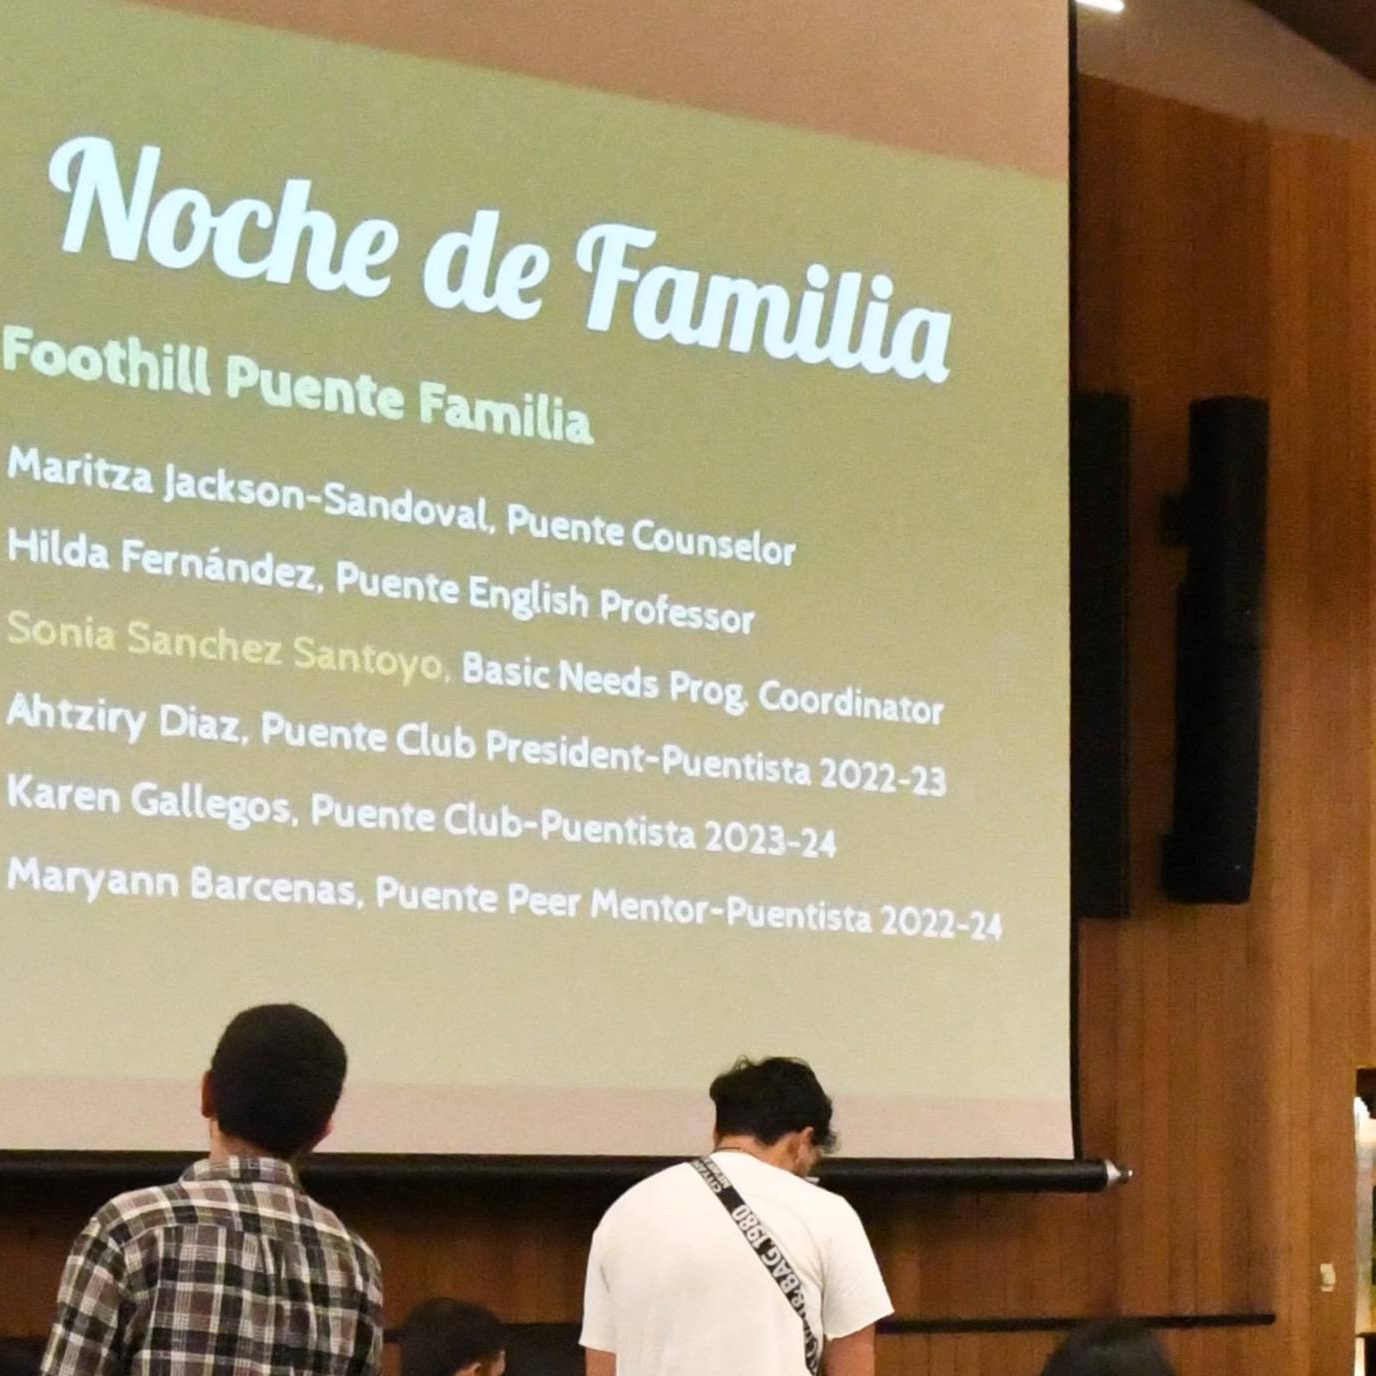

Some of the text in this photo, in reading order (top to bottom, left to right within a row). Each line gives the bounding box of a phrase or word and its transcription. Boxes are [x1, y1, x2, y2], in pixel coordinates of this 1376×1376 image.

[48, 134, 952, 384] Noche de Familia
[3, 324, 594, 445] Foothill Puente Familia
[7, 444, 796, 566] Maritza Jackson-Sandoval, Puente Counselor
[7, 527, 756, 635] Hilda Fernández, Puente English Professor
[7, 610, 944, 725] Sonia Sanchez Santoyo, Basic Needs Prog. Coordinator
[6, 691, 947, 797] Ahtziry Diaz, Puente Club President-Puentista 2022-23
[7, 773, 837, 858] Karen Gallegos, Puente Club-Puentista 2023-24
[7, 856, 1003, 941] Maryann Barcenas, Puente Peer Mentor-Puentista 2022-24
[731, 1203, 769, 1250] 1980
